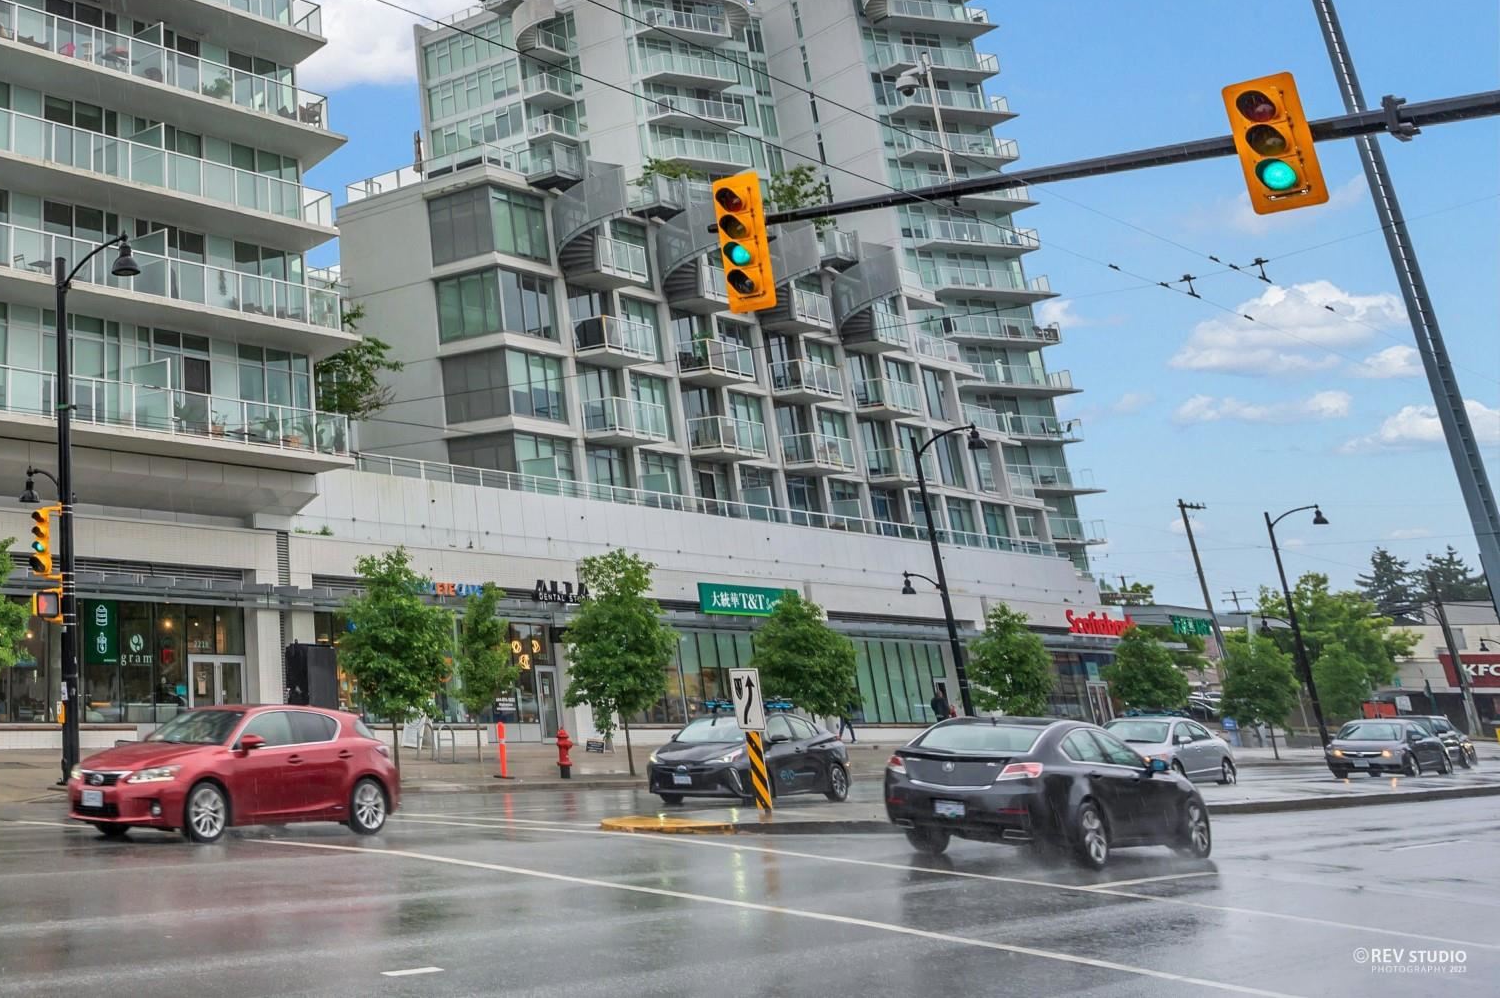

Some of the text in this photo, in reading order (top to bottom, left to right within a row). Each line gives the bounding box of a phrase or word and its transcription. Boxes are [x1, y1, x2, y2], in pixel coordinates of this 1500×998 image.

[538, 592, 565, 602] DENTAL
[739, 592, 765, 610] T&T
[120, 653, 153, 667] gram
[1462, 663, 1500, 677] KFC
